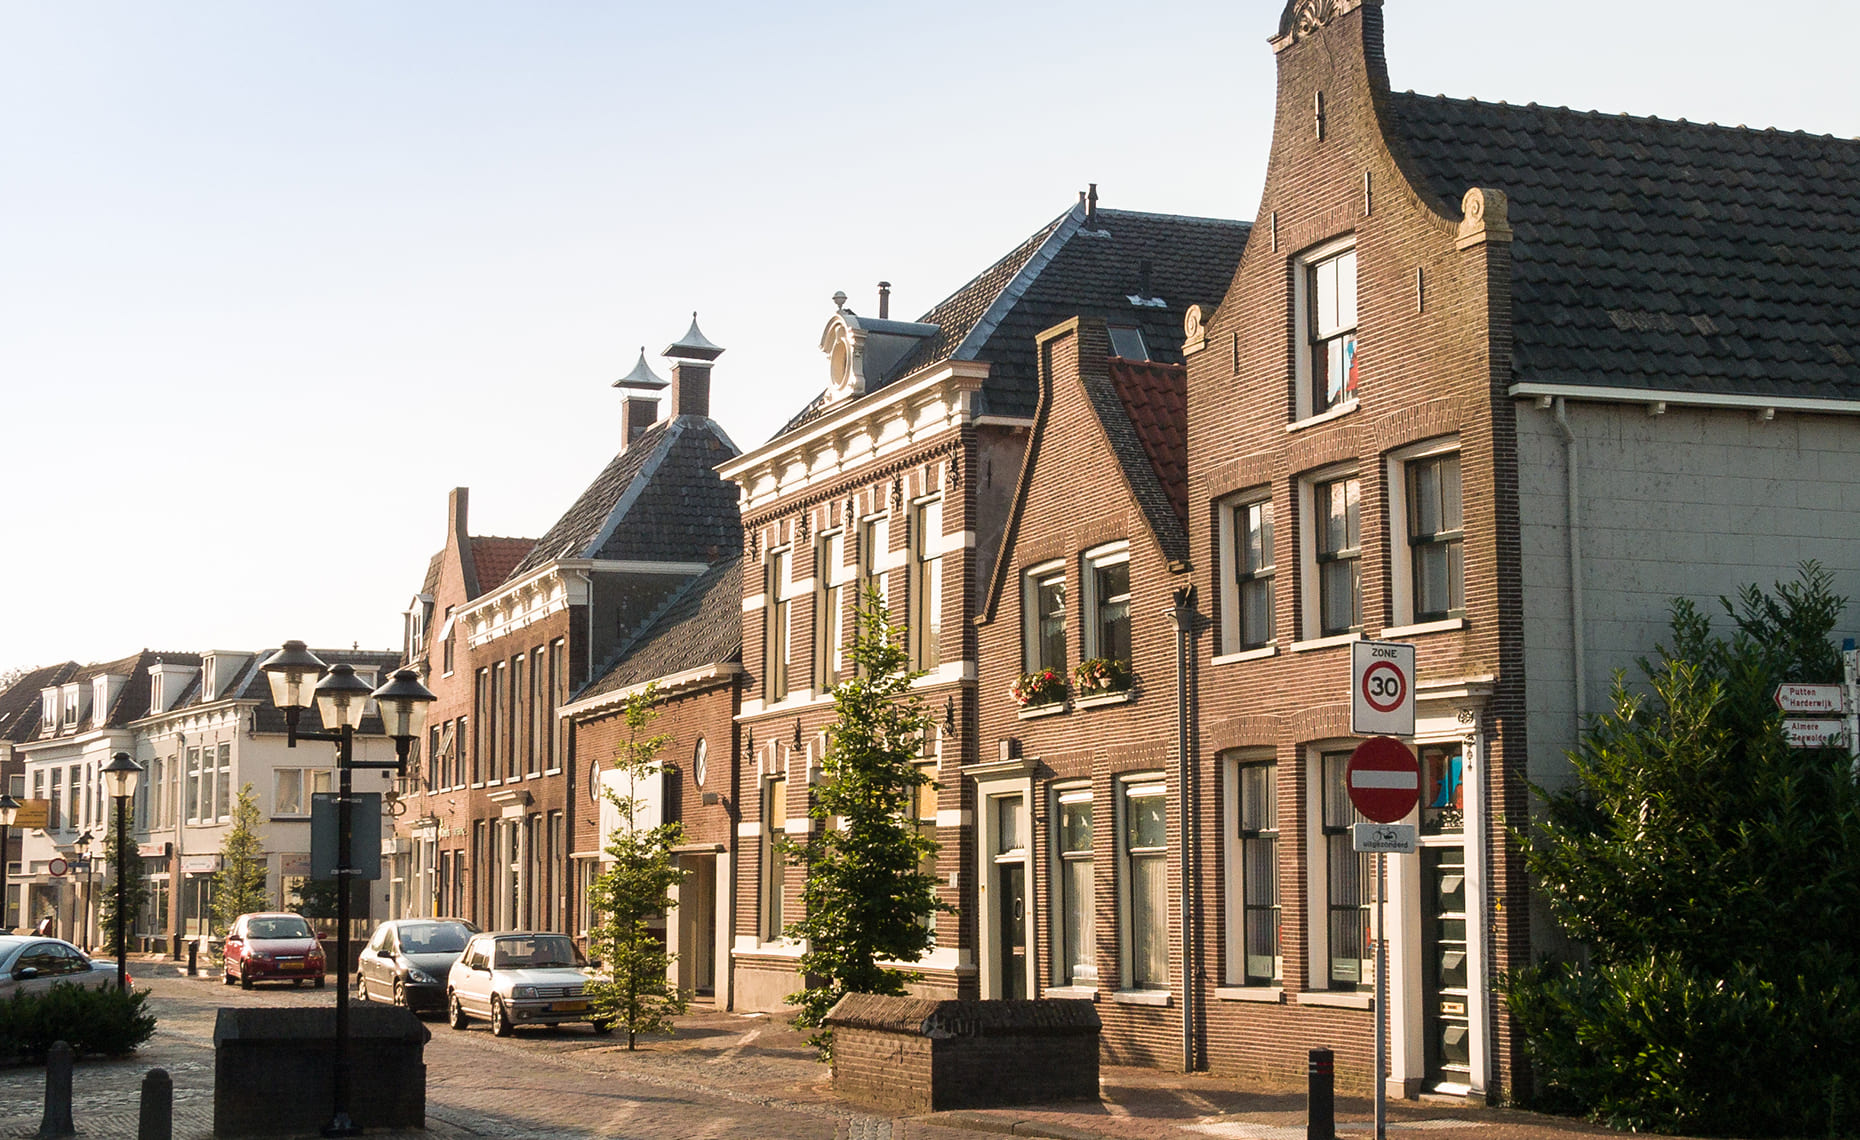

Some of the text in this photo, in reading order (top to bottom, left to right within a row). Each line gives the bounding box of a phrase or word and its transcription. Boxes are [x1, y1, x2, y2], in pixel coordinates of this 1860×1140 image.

[1371, 648, 1397, 658] ZONE
[1370, 676, 1399, 698] 30
[1789, 687, 1817, 696] Putten
[1790, 699, 1833, 709] Harderwijk
[1791, 722, 1819, 730] Almere
